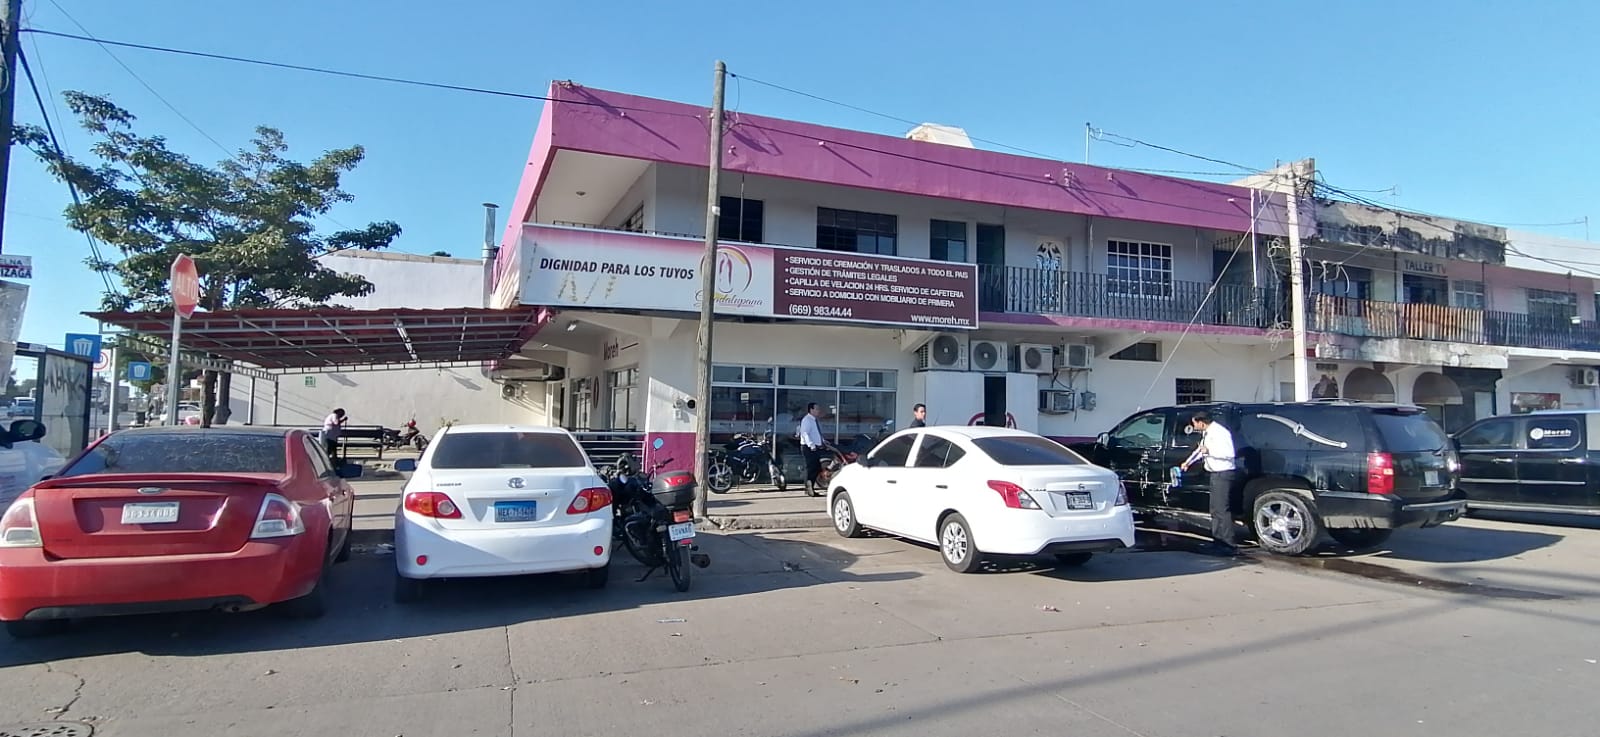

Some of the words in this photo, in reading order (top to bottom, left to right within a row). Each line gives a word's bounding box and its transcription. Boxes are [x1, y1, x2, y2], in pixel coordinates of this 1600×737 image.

[540, 258, 598, 273] DIGNIDAD
[601, 262, 631, 275] PARA
[634, 265, 656, 277] LOS
[660, 267, 695, 280] TUYOS
[789, 256, 822, 266] SERVICIO
[822, 259, 833, 267] DE
[833, 260, 874, 270] CREMACIÓN
[881, 264, 920, 275] TRASLADOS
[927, 268, 946, 277] TODO
[946, 270, 955, 278] EL
[955, 271, 969, 279] PAIS
[789, 267, 820, 276] GESTIÓN
[821, 269, 832, 277] DE
[832, 269, 866, 279] TRÁMITES
[867, 273, 898, 283] LEGALES
[1404, 258, 1434, 273] TALLER
[789, 277, 819, 287] CAPILLA
[831, 281, 865, 290] VELACION
[874, 284, 890, 292] HRS.
[890, 285, 920, 295] SERVICIO
[920, 288, 931, 296] DE
[930, 289, 965, 299] CAFETERIA
[789, 288, 822, 298] SERVICIO
[822, 291, 829, 299] A
[829, 291, 864, 301] DOMICILIO
[864, 294, 880, 302] CON
[880, 294, 918, 305] MOBILIARIO
[917, 298, 928, 306] DE
[927, 299, 956, 308] PRIMERA
[788, 304, 812, 316] (669)
[813, 306, 852, 317] 983.44.44
[910, 315, 970, 326] www.moreh.mx
[603, 337, 619, 361] Moreh
